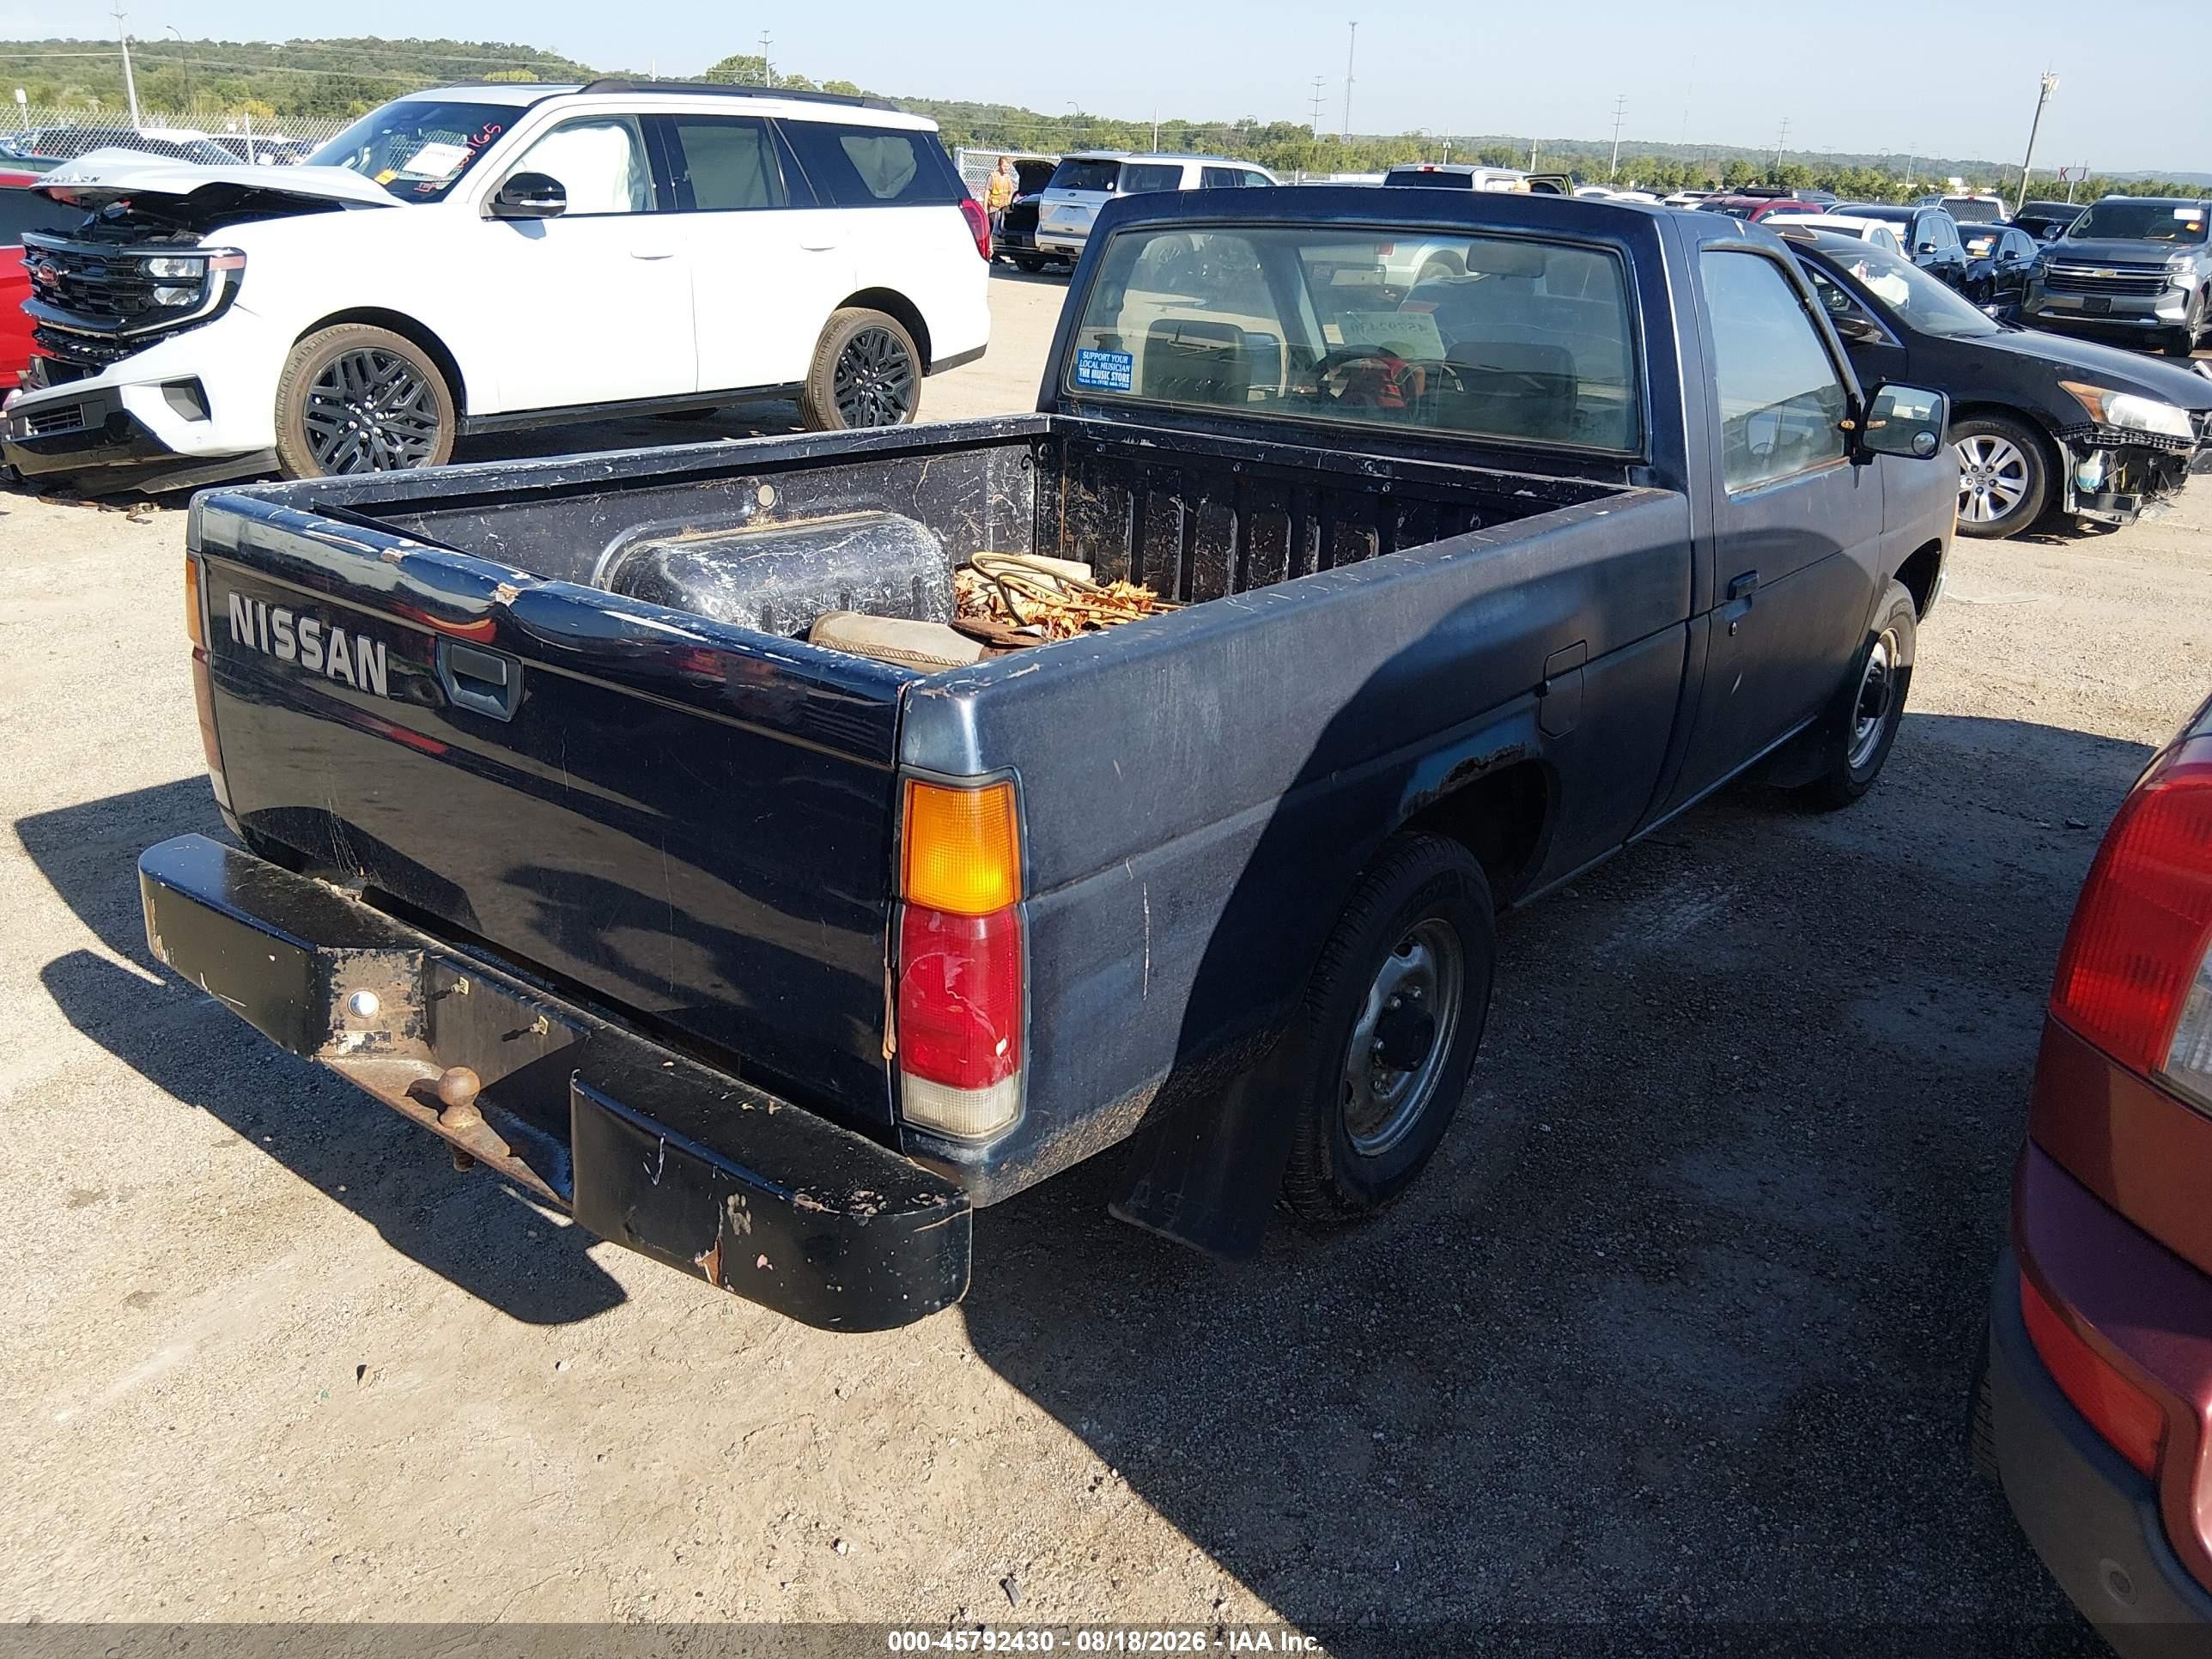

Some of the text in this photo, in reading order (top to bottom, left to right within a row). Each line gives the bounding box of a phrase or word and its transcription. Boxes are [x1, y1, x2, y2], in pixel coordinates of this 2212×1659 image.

[1082, 350, 1129, 364] SUPPORT YOUR
[1079, 359, 1131, 373] LOCAL MUSICIAN
[1079, 368, 1131, 384] THE MUSIC STORE
[228, 592, 389, 699] NISSAN
